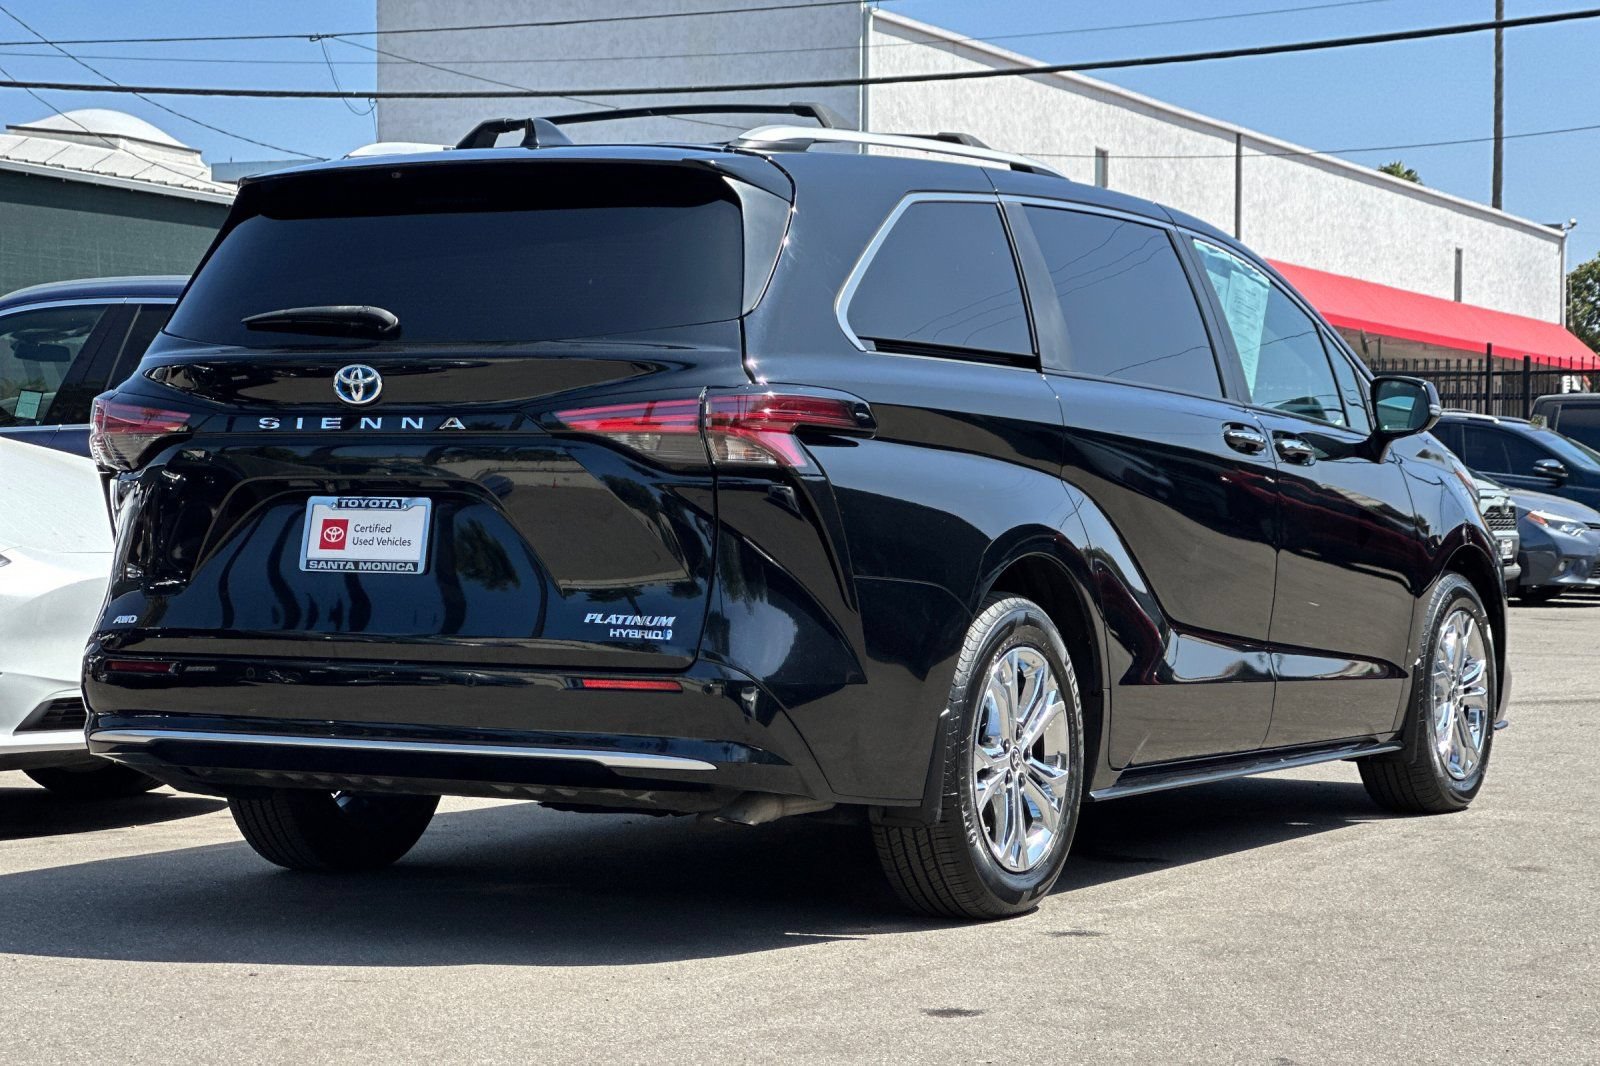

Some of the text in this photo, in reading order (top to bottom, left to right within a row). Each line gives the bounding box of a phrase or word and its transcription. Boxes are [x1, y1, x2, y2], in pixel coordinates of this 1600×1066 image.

[259, 417, 466, 430] SIENNA
[339, 499, 399, 508] TOYOTA
[353, 523, 392, 533] Certified
[352, 537, 412, 547] Used Vehicles
[309, 560, 415, 572] SANTA MONICA
[113, 615, 137, 623] AWD
[584, 613, 676, 626] PLATINUM
[610, 629, 664, 639] HYBRID
